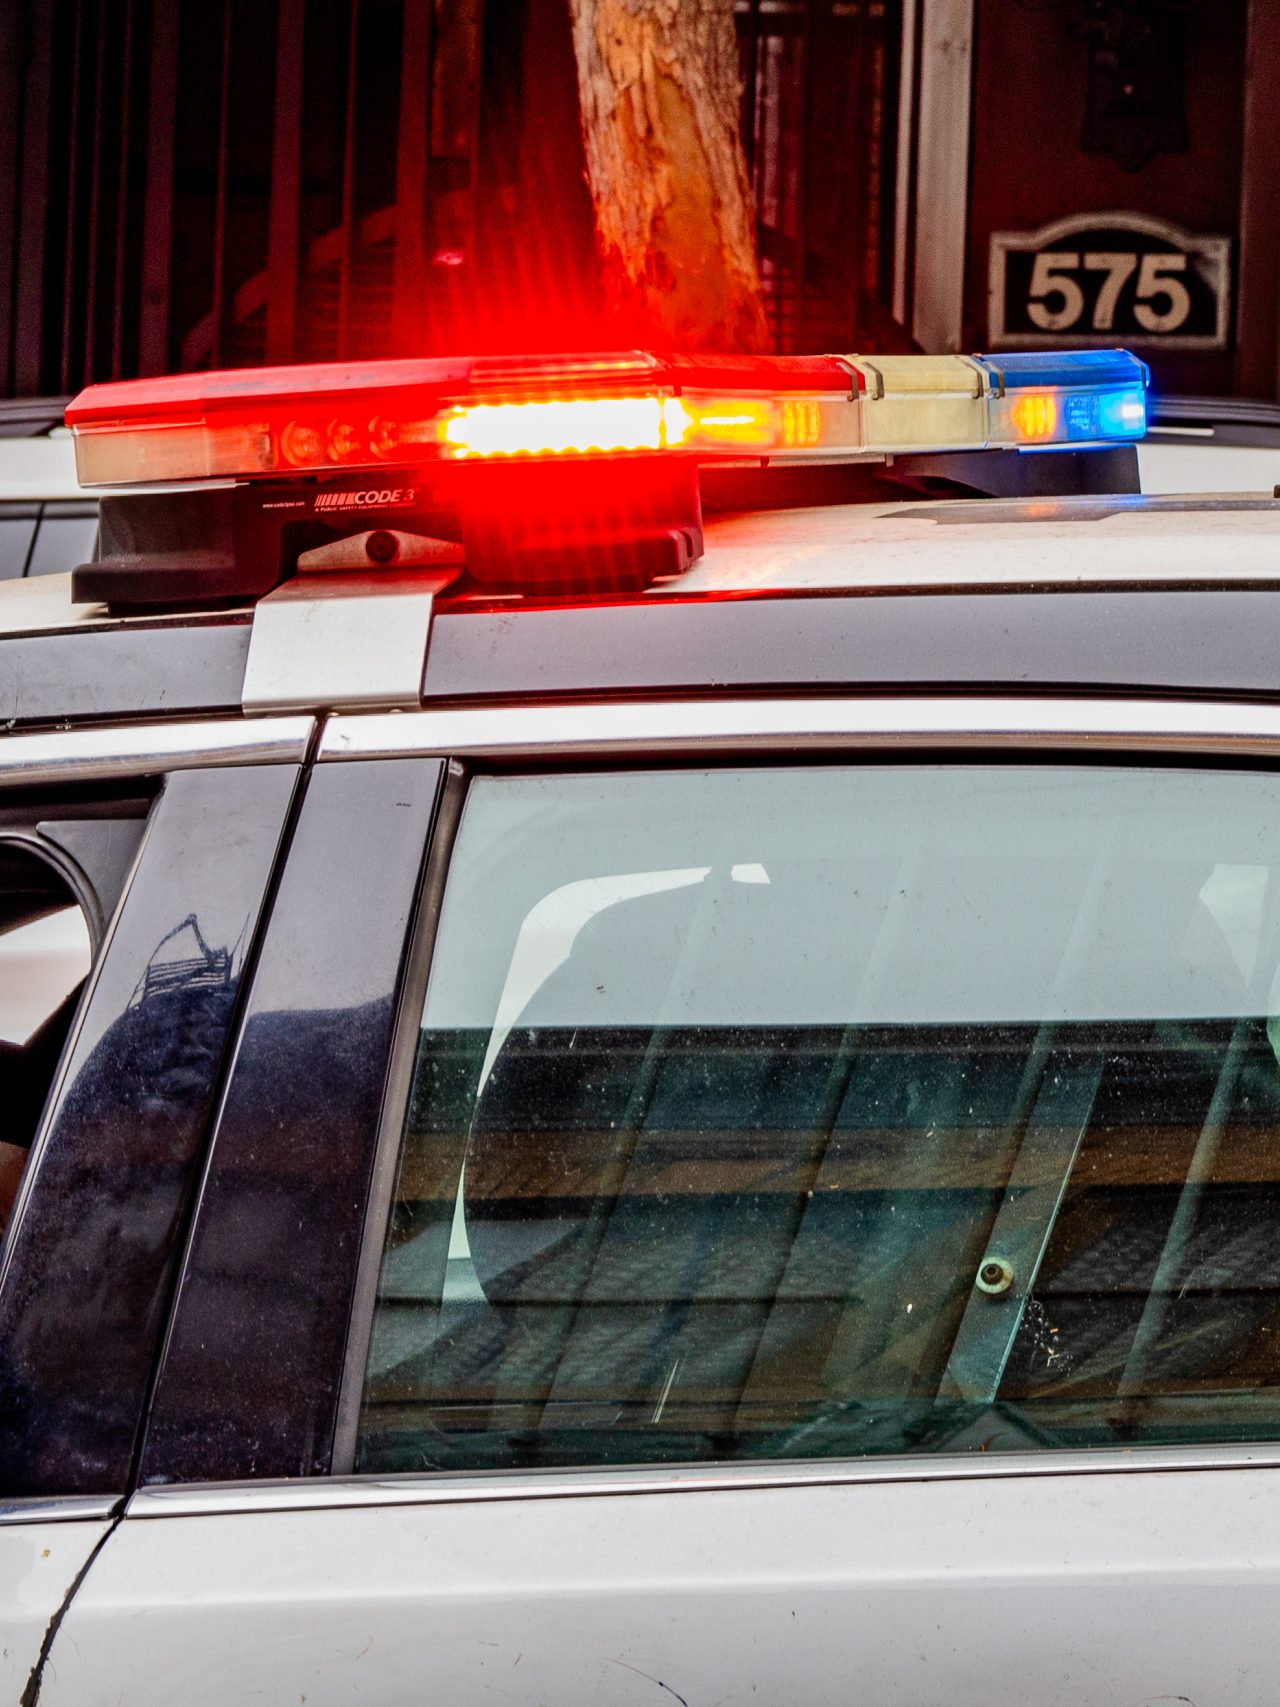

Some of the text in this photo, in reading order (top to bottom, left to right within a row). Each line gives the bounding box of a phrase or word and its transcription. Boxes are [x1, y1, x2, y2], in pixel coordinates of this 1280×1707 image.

[1026, 252, 1191, 333] 575
[354, 488, 415, 505] CODE 3
